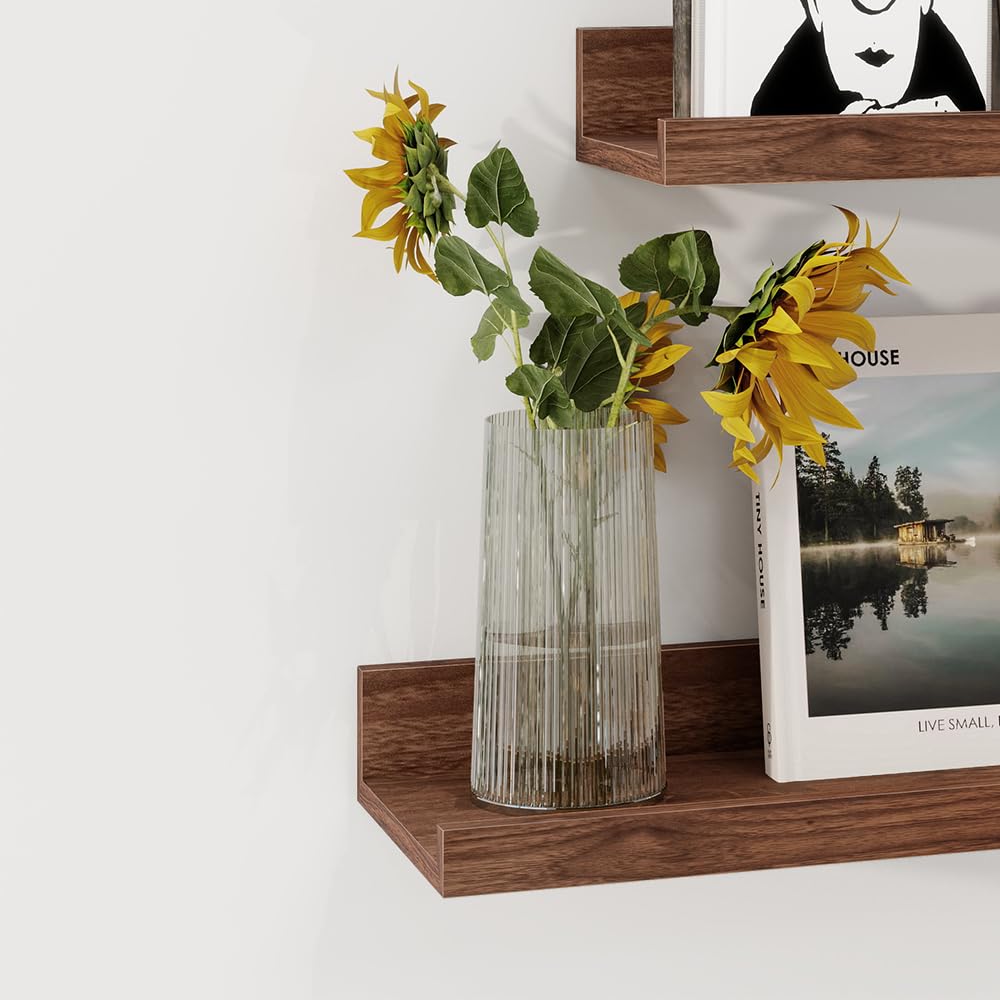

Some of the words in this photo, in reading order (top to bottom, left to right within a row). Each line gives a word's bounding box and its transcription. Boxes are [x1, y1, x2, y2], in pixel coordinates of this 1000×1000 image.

[838, 349, 900, 367] HOUSE
[755, 491, 763, 536] TINY
[757, 543, 766, 610] HOUSE
[918, 719, 945, 733] LIVE
[948, 716, 995, 731] SMALL,
